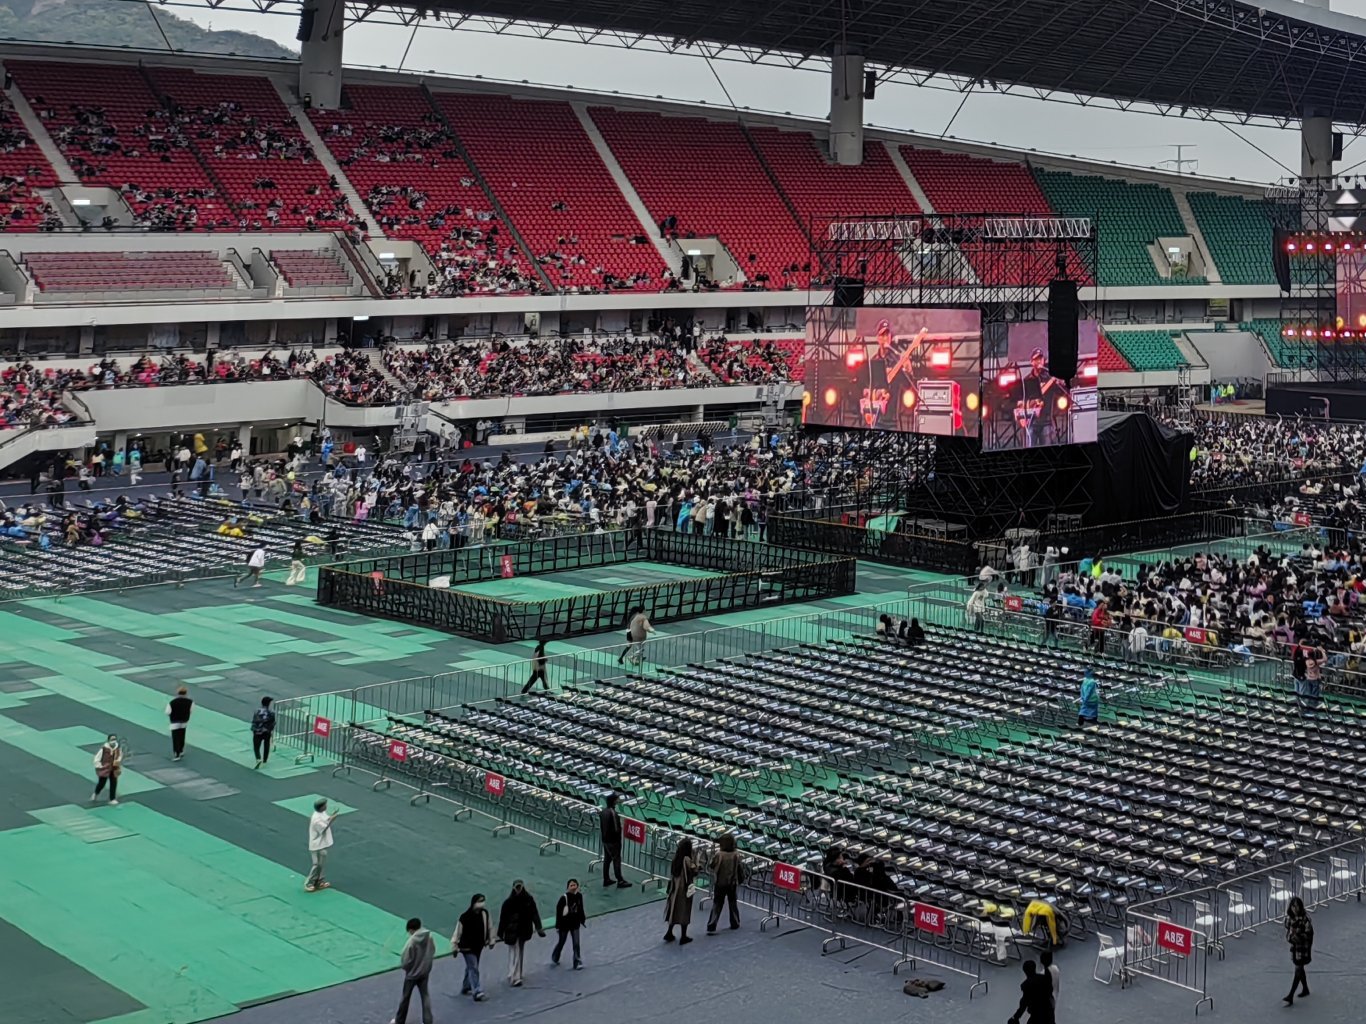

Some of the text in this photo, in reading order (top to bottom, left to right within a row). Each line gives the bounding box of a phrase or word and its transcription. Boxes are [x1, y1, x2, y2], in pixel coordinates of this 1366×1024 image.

[779, 869, 795, 884] A8区
[920, 910, 939, 927] A8区
[1164, 930, 1185, 947] A8区
